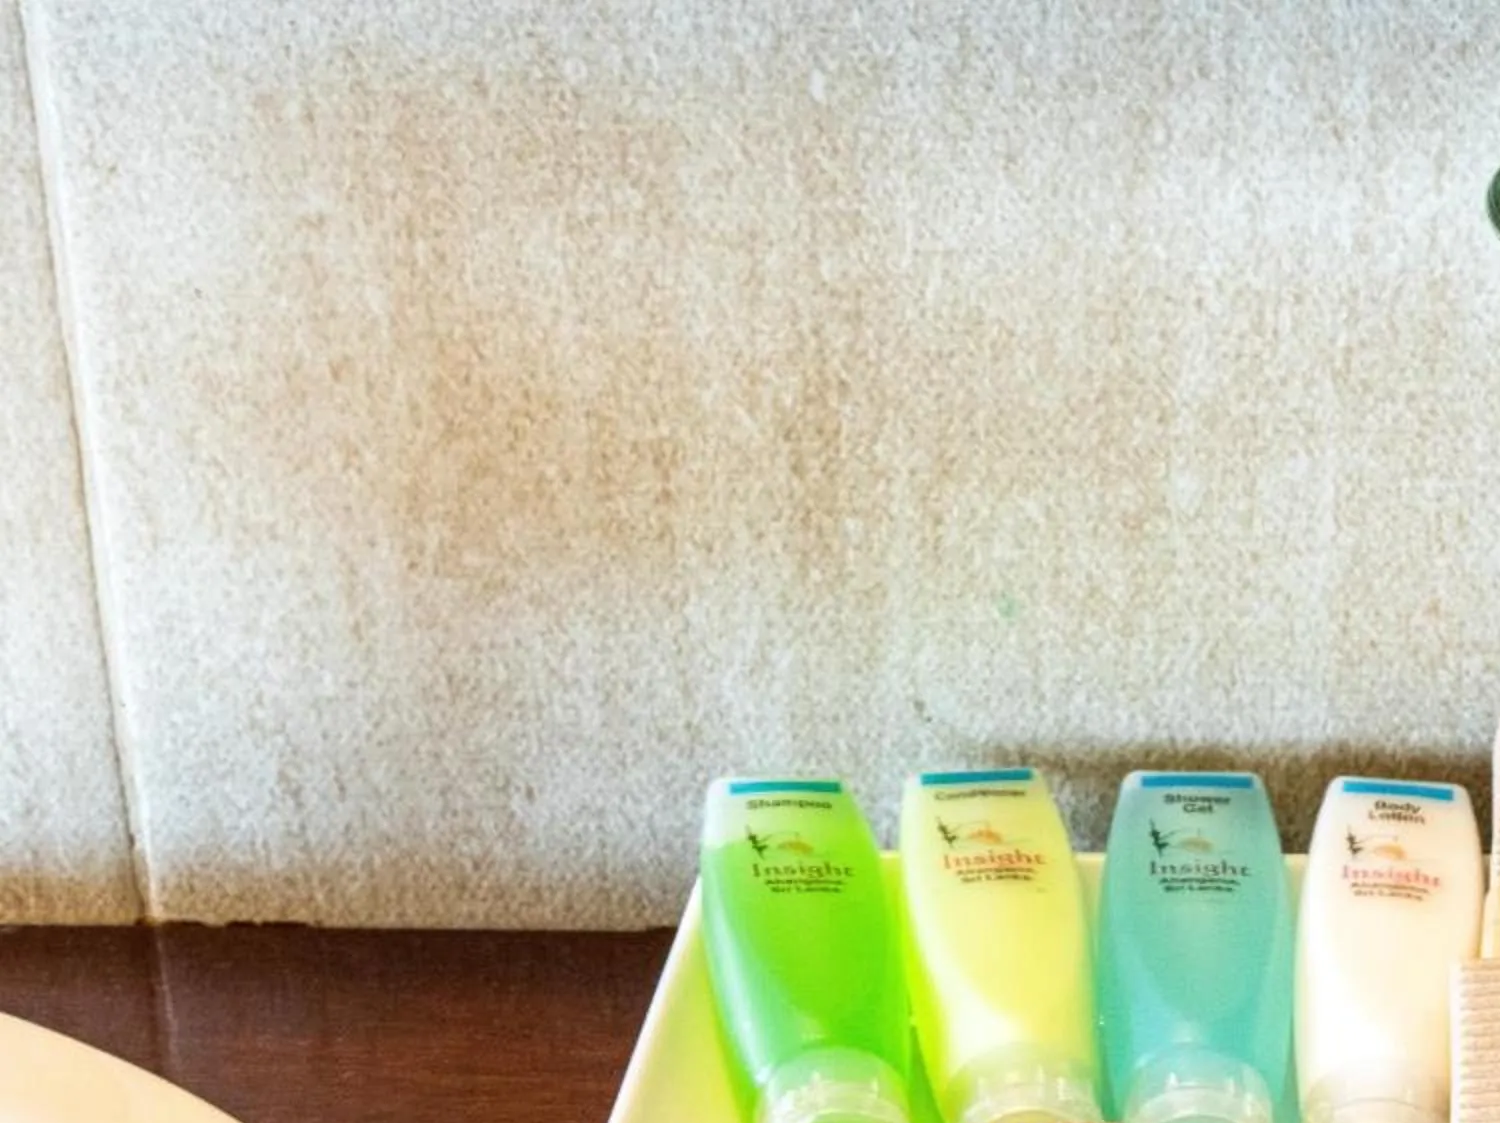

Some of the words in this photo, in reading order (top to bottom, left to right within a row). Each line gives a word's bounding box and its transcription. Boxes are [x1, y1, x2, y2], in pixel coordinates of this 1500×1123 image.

[745, 799, 833, 810] Shampoo
[1164, 793, 1231, 805] Shower
[1183, 803, 1214, 814] Gel
[1375, 800, 1421, 814] Body
[1368, 810, 1425, 825] Lotion
[943, 848, 1048, 869] Insight
[752, 861, 855, 879] Insight
[1150, 859, 1253, 879] Insight
[1342, 864, 1441, 887] Insight
